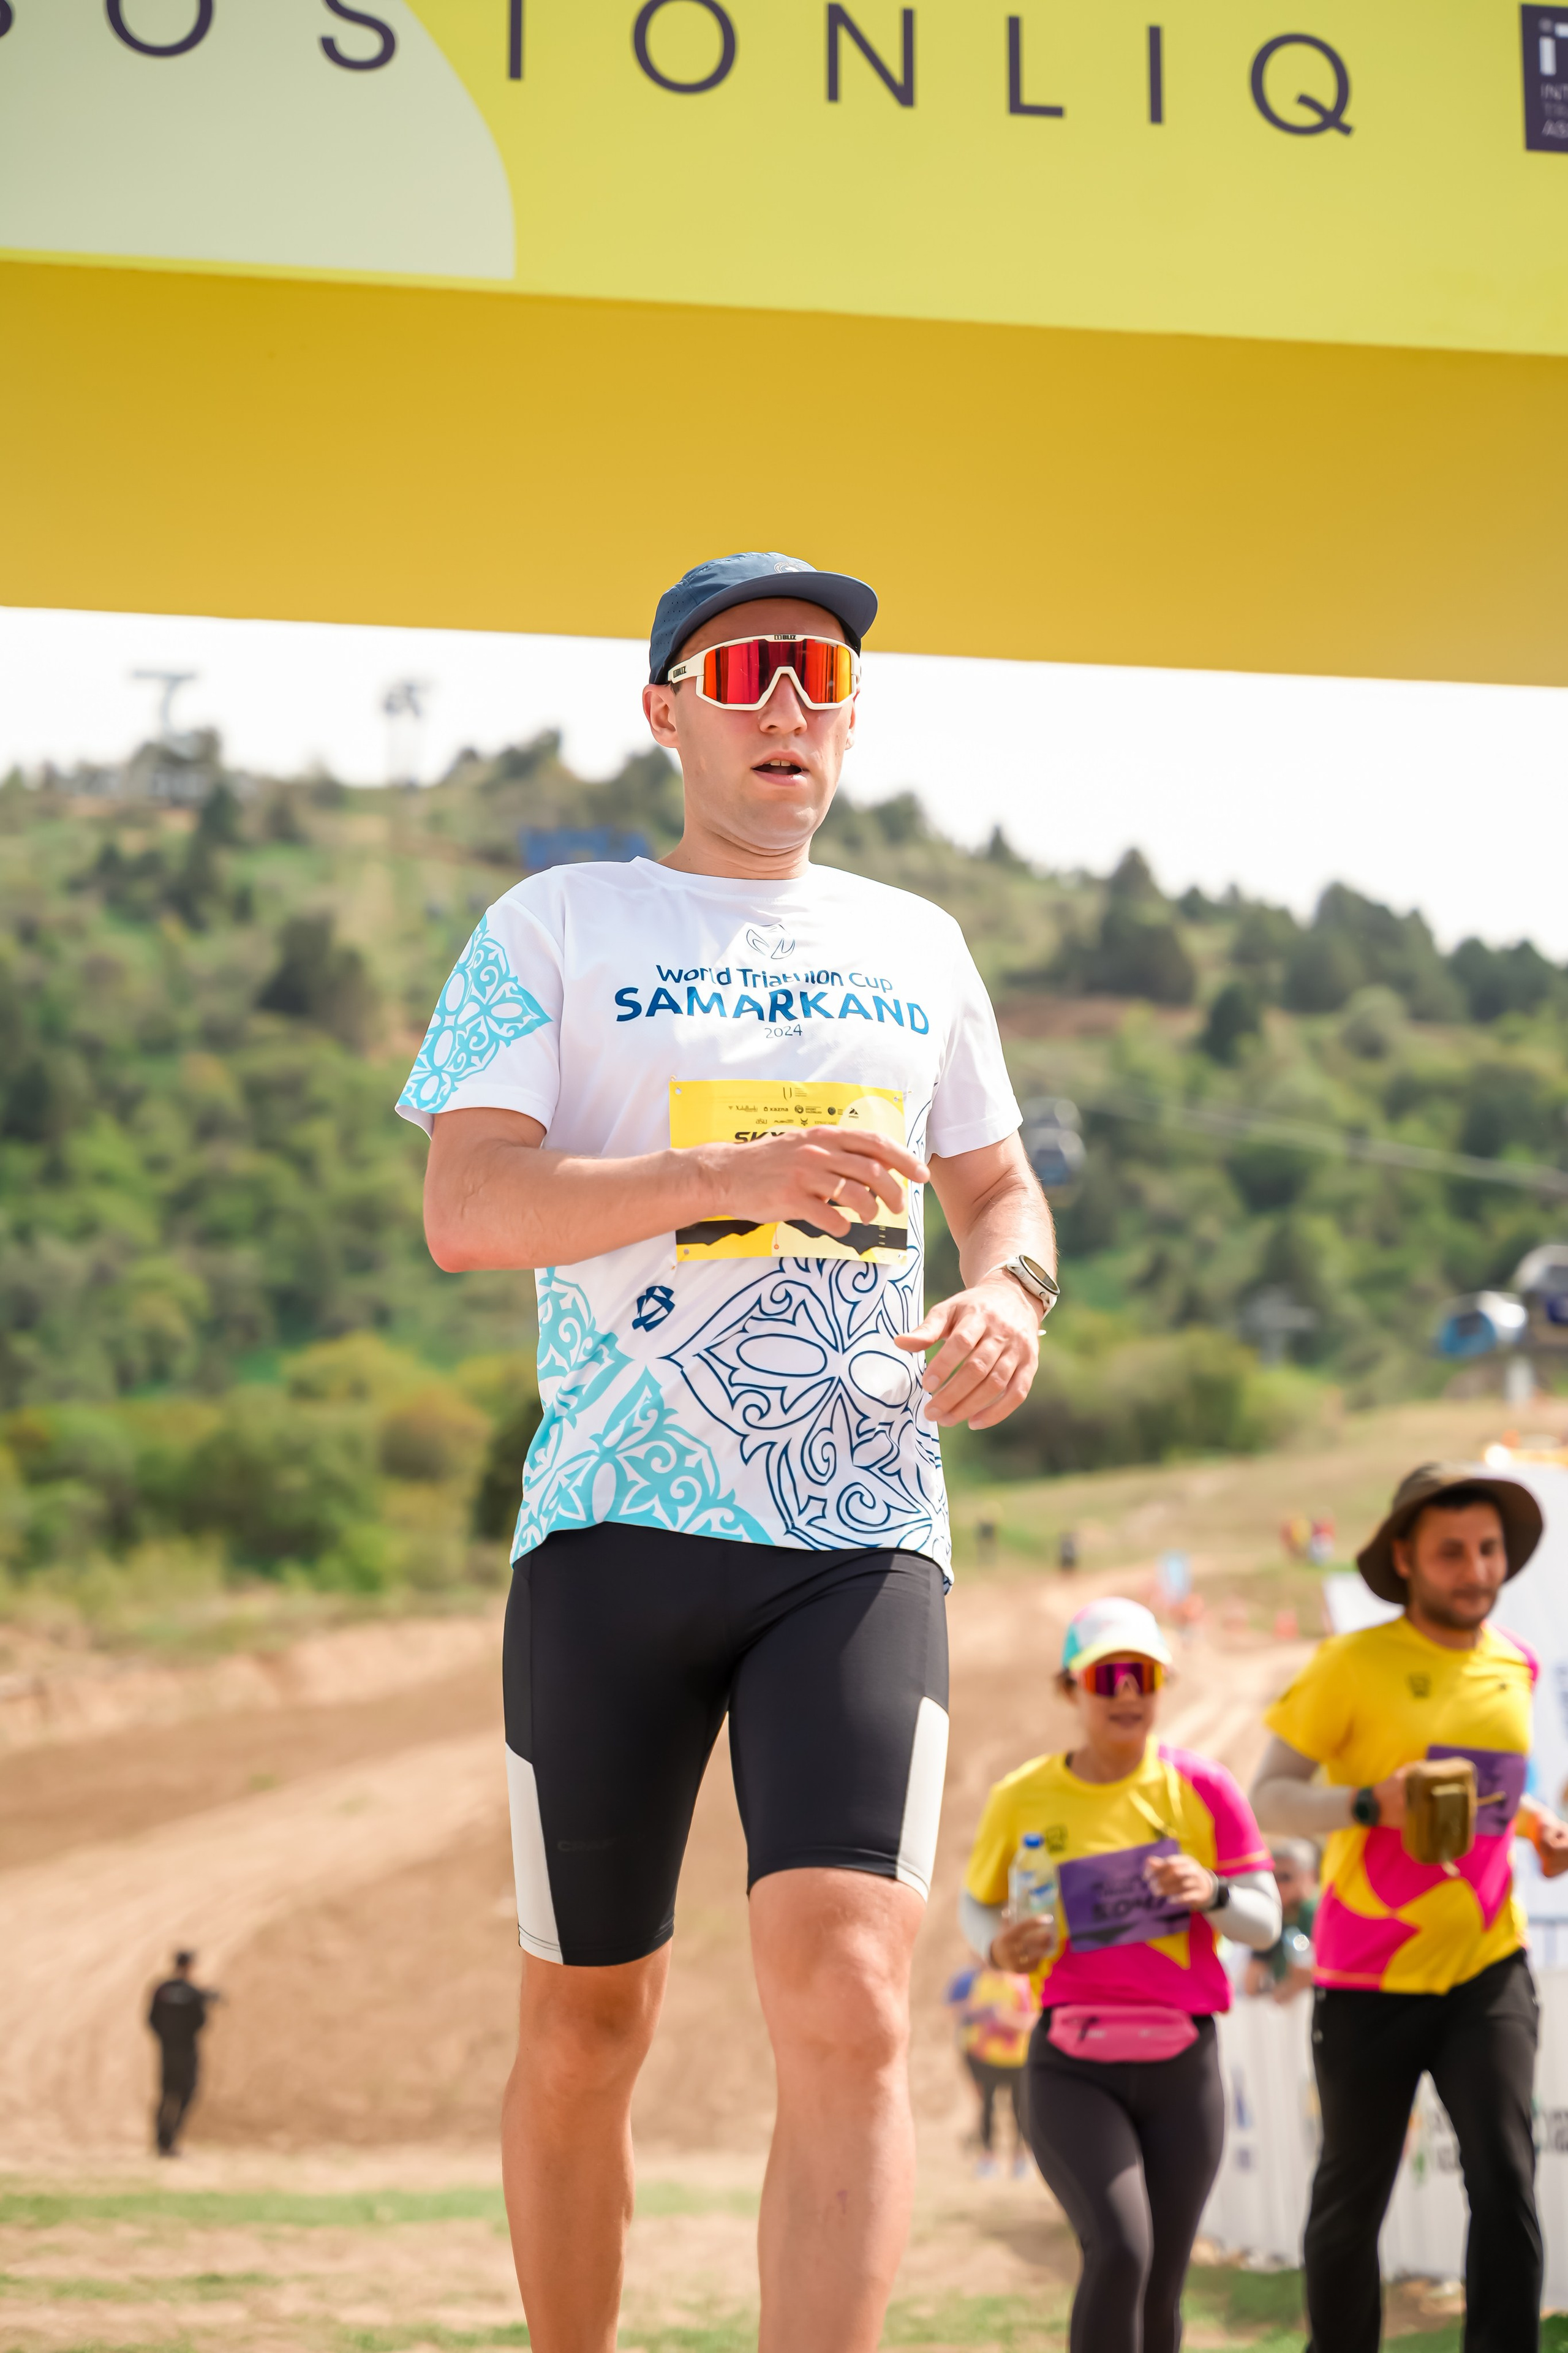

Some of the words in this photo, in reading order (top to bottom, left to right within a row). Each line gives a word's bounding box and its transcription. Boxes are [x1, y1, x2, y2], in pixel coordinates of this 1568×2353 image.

[655, 964, 732, 986] World
[848, 972, 893, 993] Cup
[614, 986, 930, 1035] SAMARKAND
[764, 1024, 803, 1039] 2024
